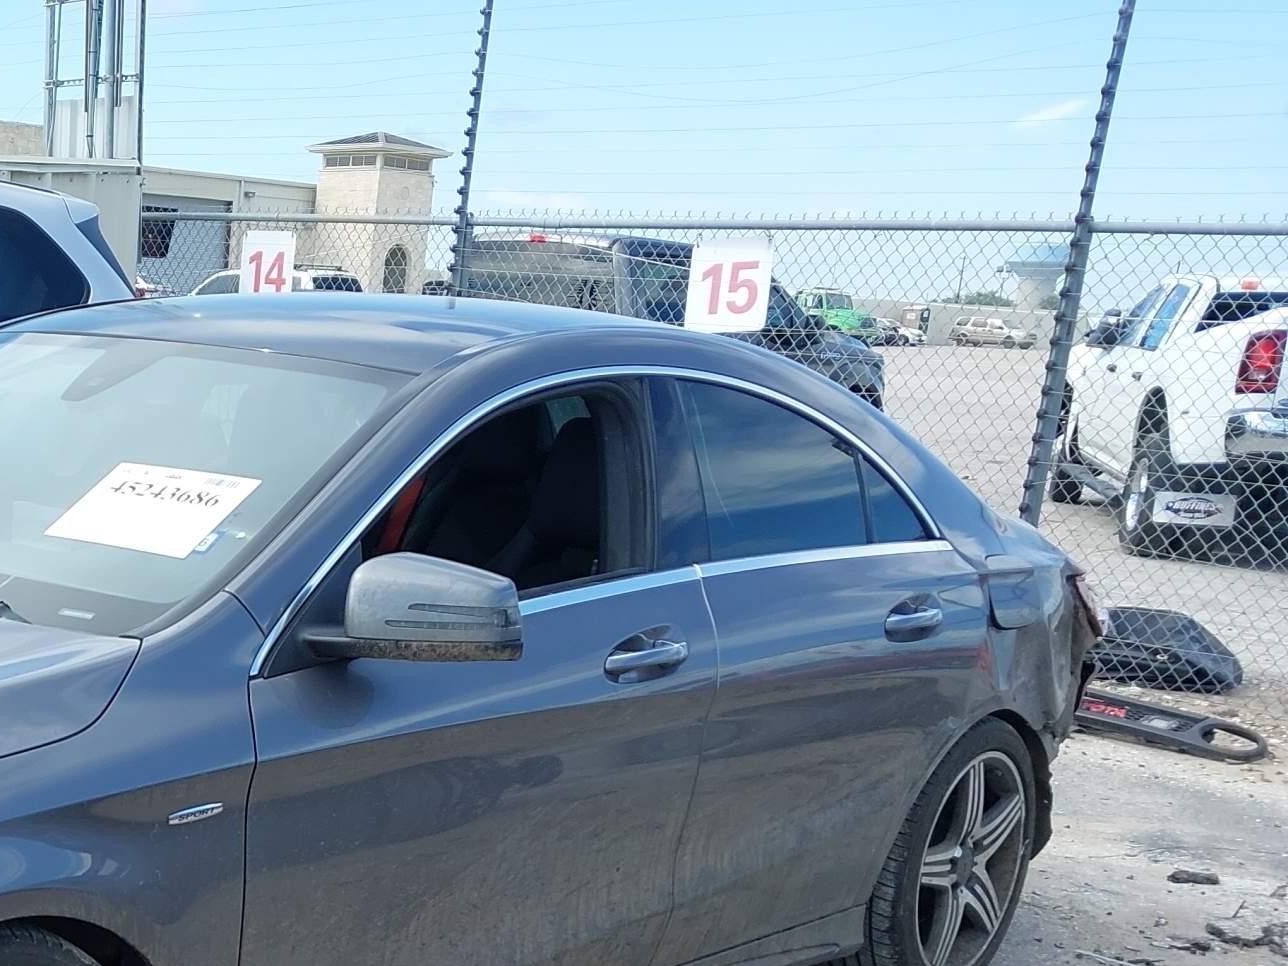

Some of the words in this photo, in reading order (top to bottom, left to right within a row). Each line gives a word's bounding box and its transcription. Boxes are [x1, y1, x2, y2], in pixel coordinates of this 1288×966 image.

[248, 251, 287, 293] 14
[701, 260, 760, 315] 15
[110, 480, 220, 508] 45243686
